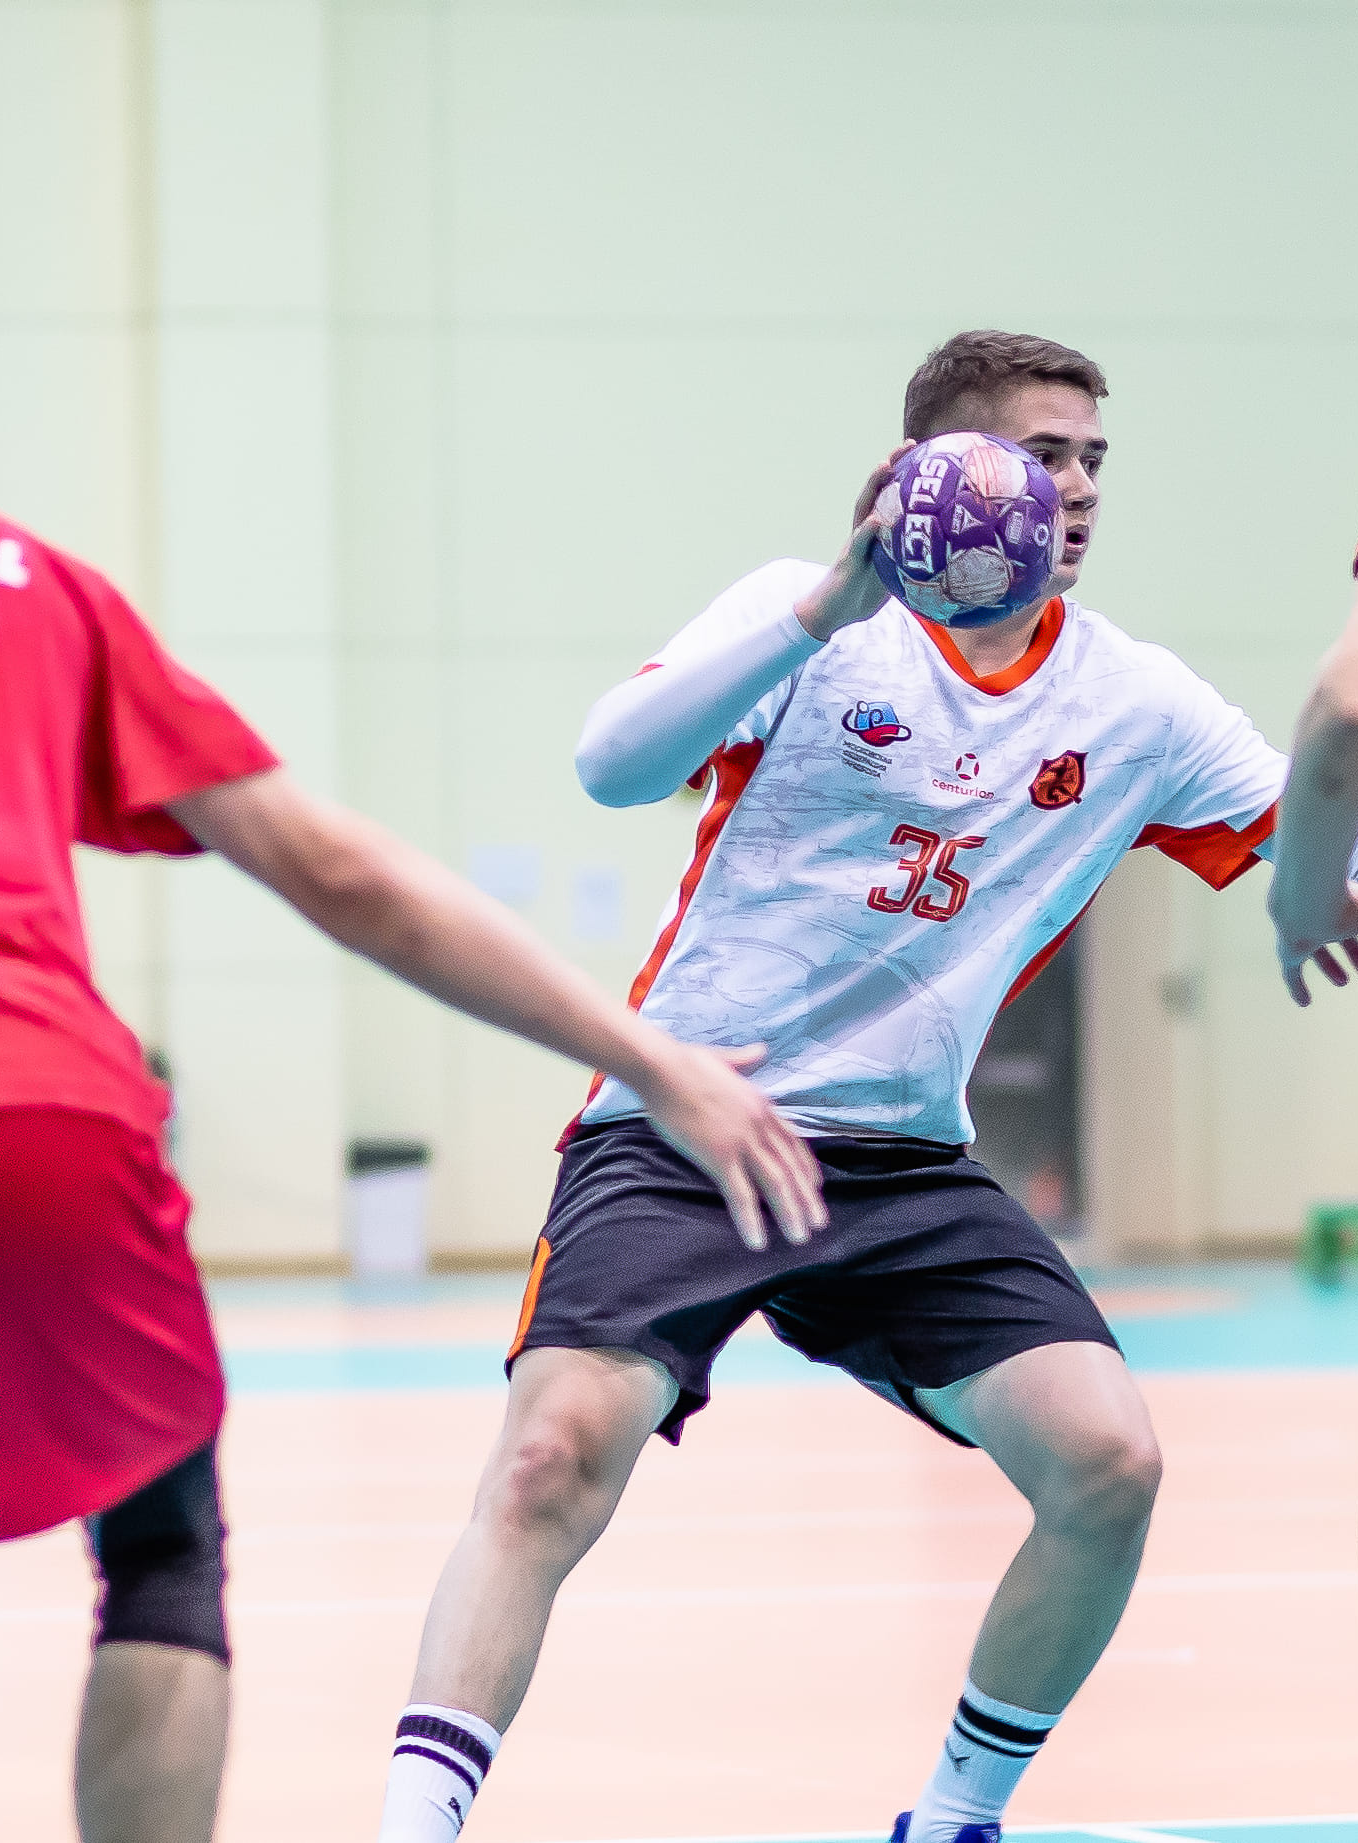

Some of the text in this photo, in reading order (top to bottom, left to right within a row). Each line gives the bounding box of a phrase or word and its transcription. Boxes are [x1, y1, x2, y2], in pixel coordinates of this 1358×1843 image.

[904, 457, 948, 573] SELECT
[932, 778, 994, 800] centurion
[867, 824, 989, 922] 35
